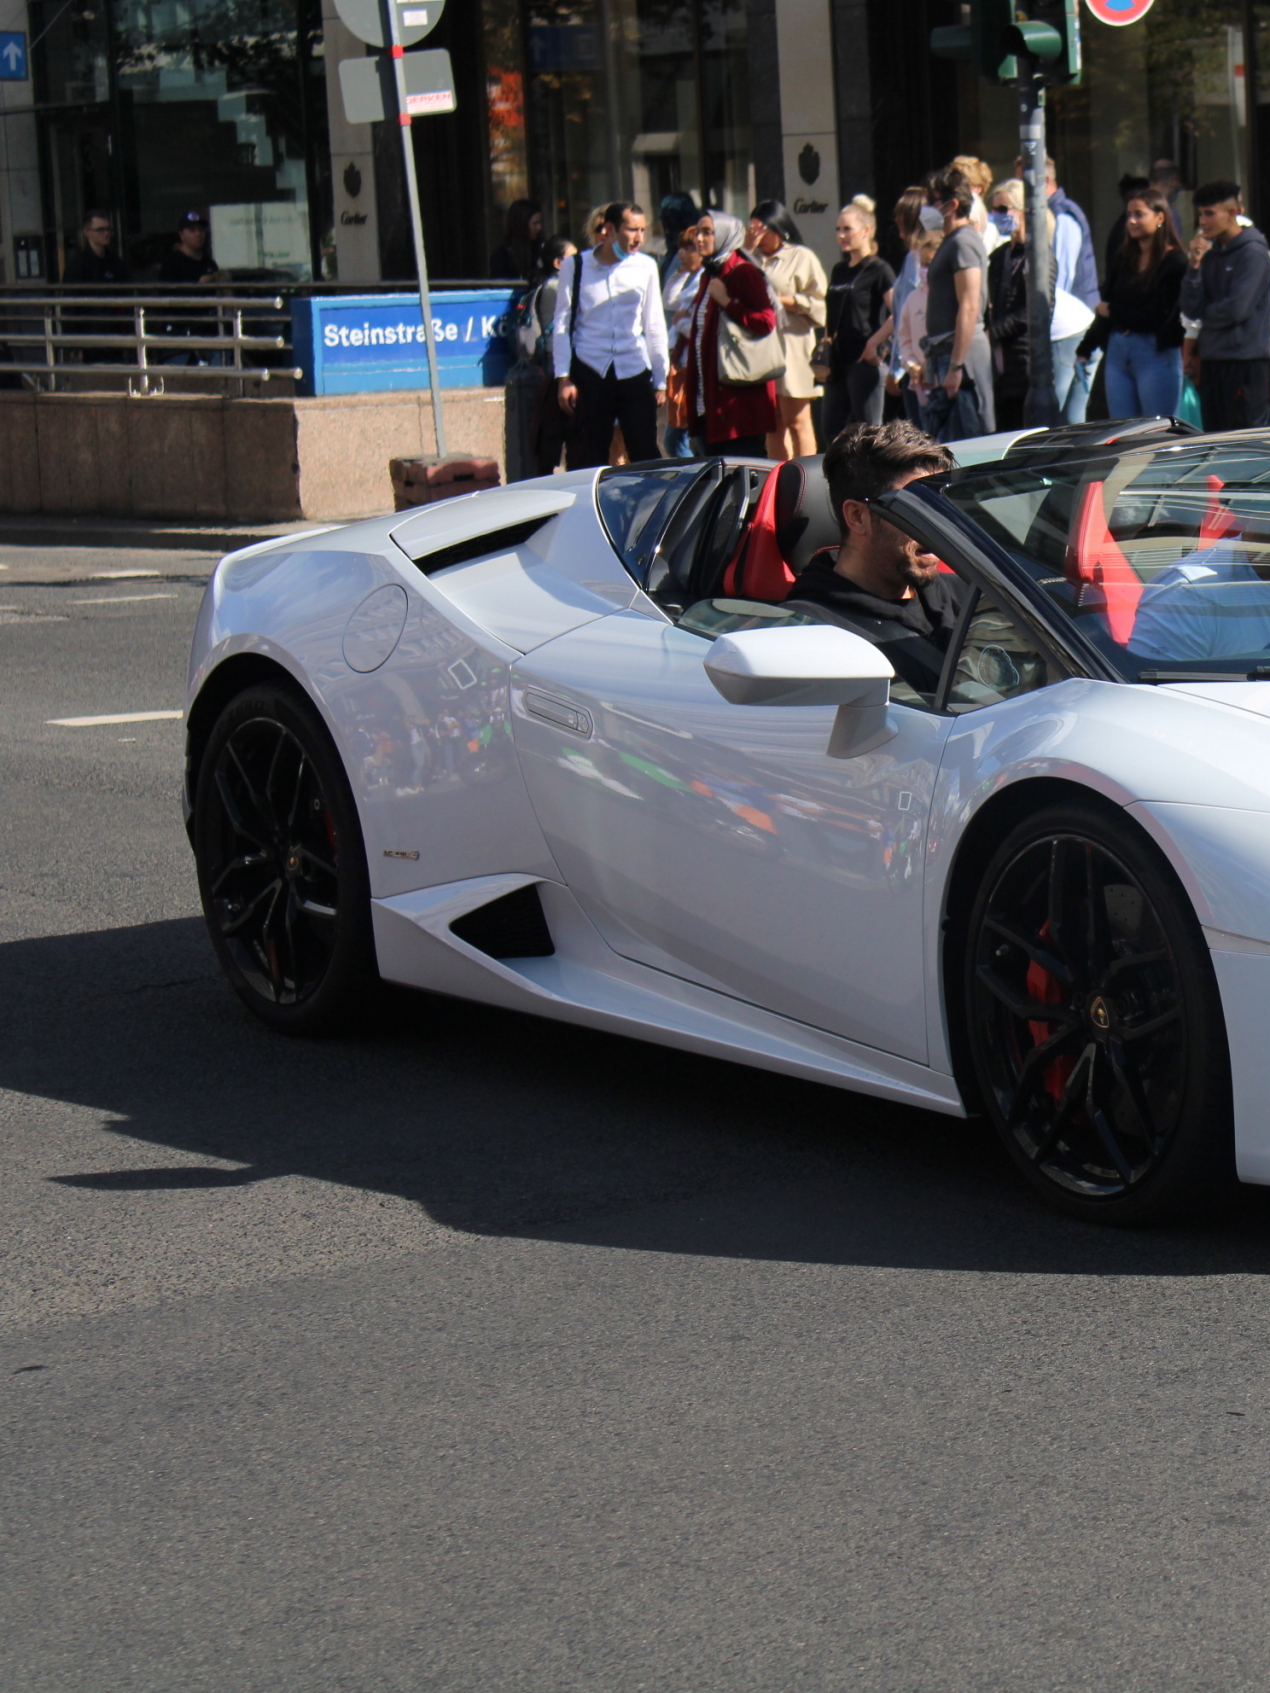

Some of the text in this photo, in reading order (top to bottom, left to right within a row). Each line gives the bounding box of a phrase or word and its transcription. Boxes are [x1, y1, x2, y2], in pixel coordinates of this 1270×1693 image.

[793, 197, 829, 214] Cartier
[340, 211, 368, 226] Cartier
[324, 319, 458, 347] Steinstraße
